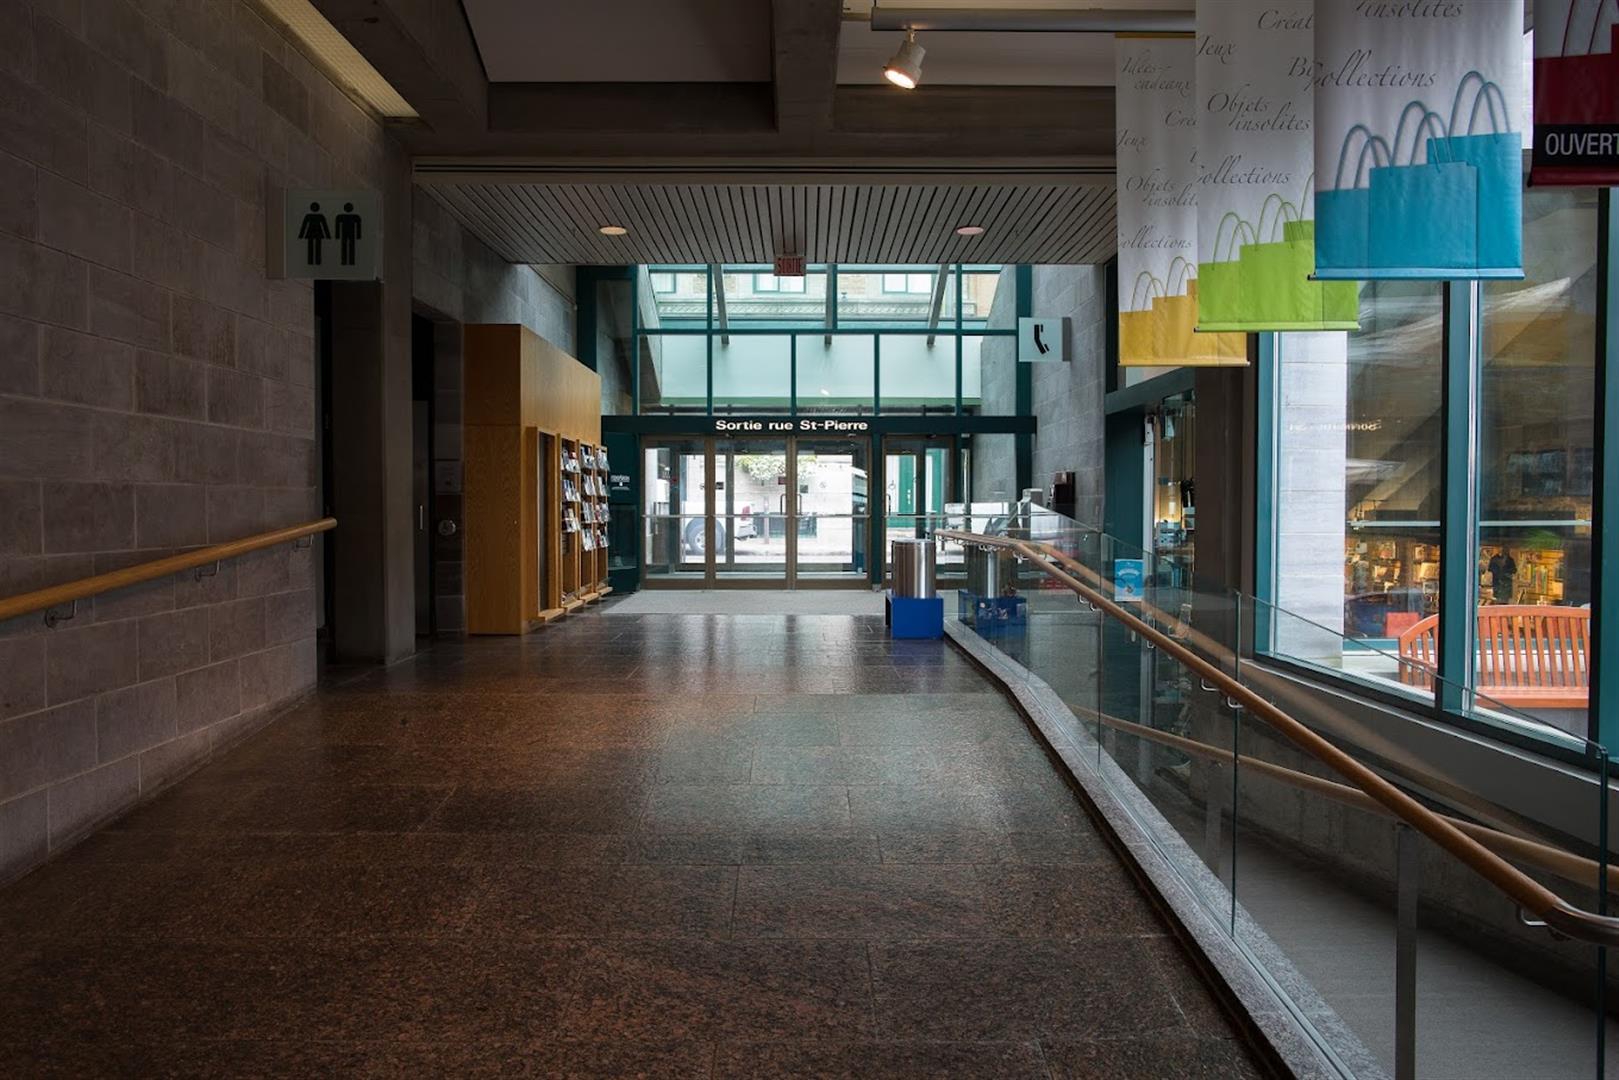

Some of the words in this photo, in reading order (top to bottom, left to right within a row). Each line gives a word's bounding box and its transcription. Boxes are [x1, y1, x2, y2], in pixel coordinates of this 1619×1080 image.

[1207, 83, 1268, 125] Objets
[1234, 101, 1311, 131] insolites
[1119, 223, 1192, 249] ollections
[715, 420, 762, 430] Sortie
[768, 421, 793, 430] rue
[799, 420, 868, 430] St-Pierre
